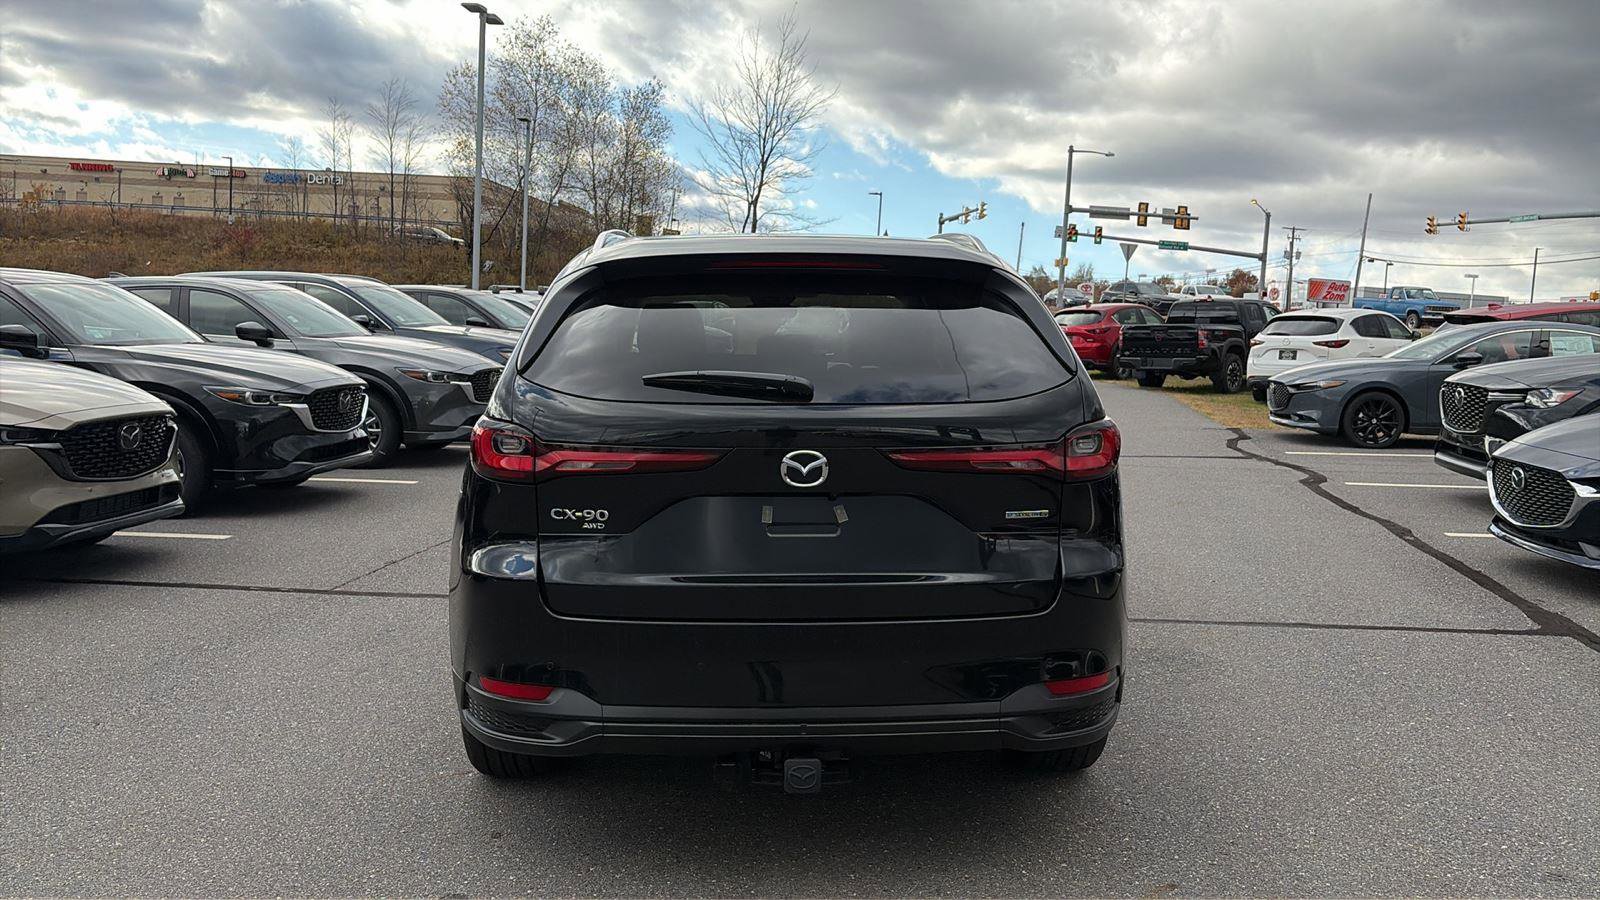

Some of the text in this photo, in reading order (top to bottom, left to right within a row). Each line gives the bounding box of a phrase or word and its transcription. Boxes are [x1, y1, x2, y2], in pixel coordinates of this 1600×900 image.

[208, 167, 246, 178] Gametop
[307, 172, 344, 185] Dental
[1328, 281, 1350, 292] Auto
[1322, 290, 1345, 301] Zone
[550, 508, 609, 521] CX-90
